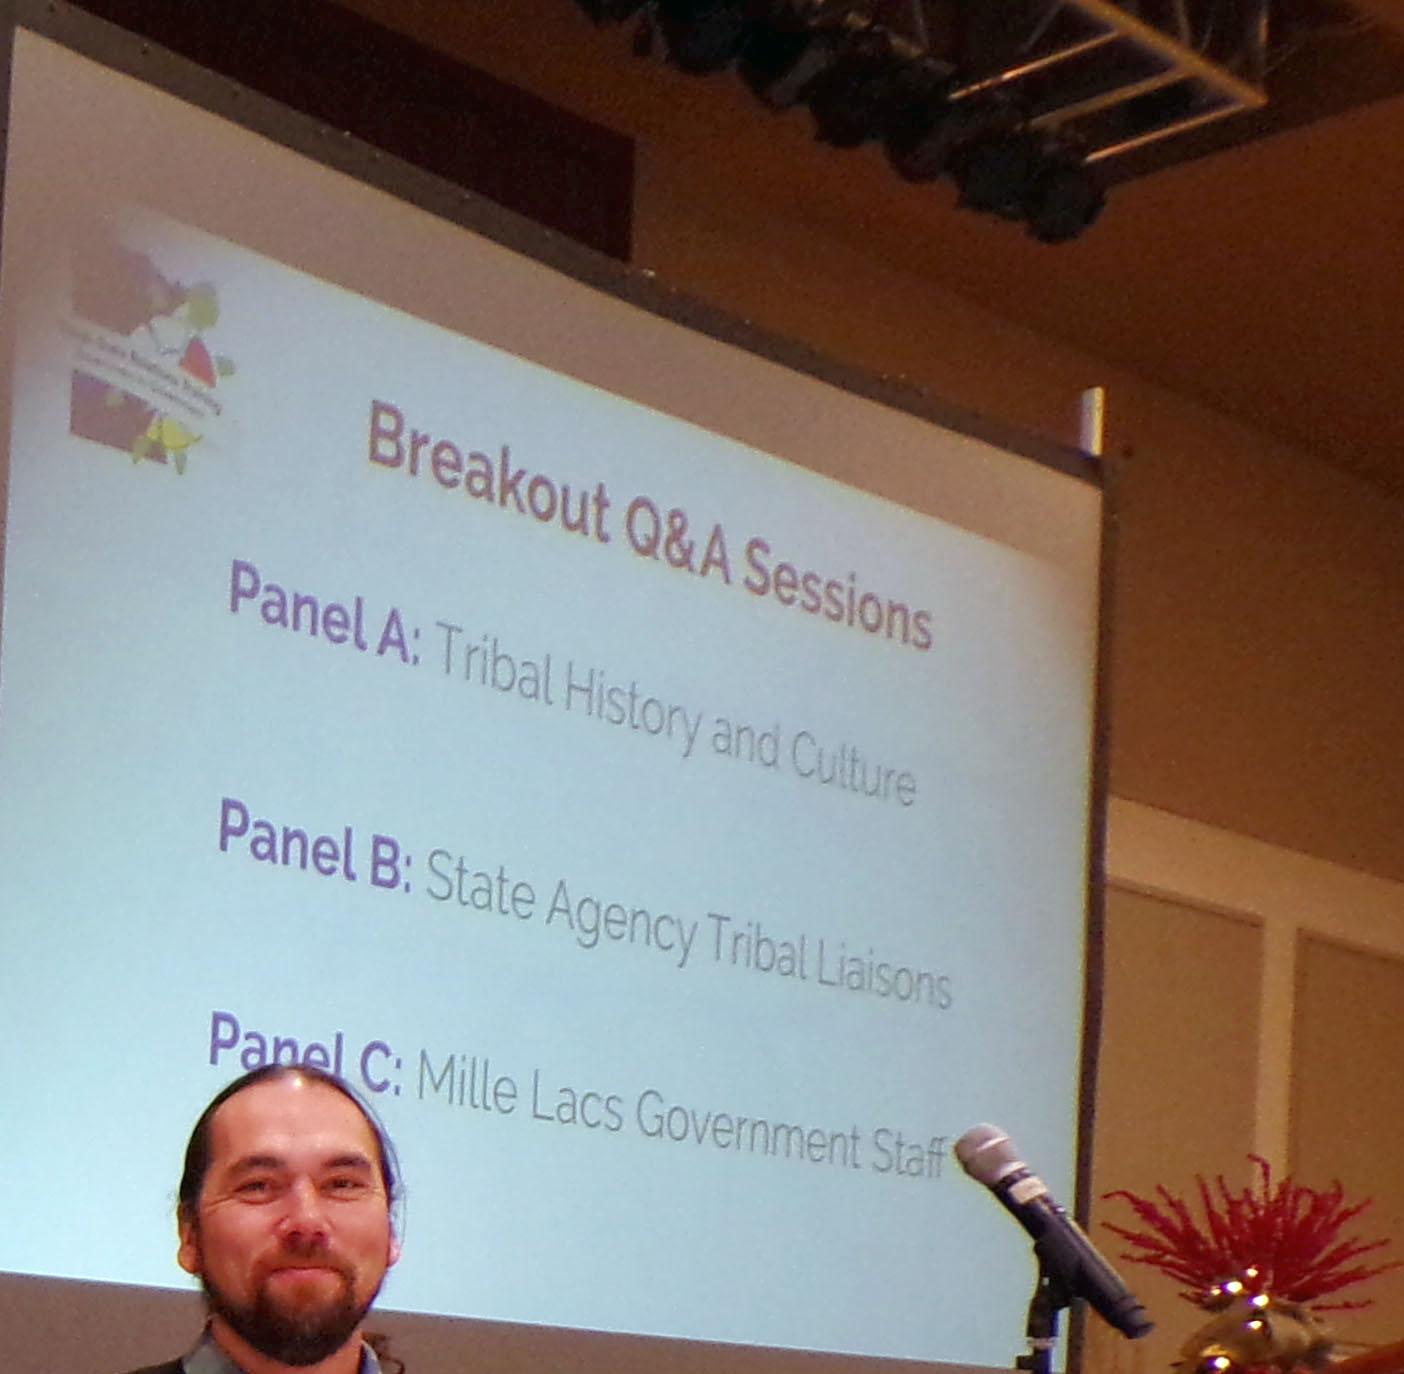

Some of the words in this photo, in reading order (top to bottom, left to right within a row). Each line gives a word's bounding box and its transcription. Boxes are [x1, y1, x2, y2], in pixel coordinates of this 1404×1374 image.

[369, 399, 611, 543] Breakout
[626, 495, 730, 585] Q&A
[743, 537, 932, 650] Sessions
[230, 559, 368, 652] Panel
[376, 607, 420, 666] A:
[436, 620, 552, 706] Tribal
[566, 660, 703, 759] History
[712, 717, 780, 768] and
[792, 730, 917, 807] Culture
[220, 797, 357, 881] Panel
[370, 833, 411, 893] B:
[427, 849, 535, 920] State
[545, 879, 698, 968] Agency
[708, 912, 807, 981] Tribal
[818, 938, 952, 1010] Liaisons
[209, 1010, 344, 1076] Panel
[360, 1040, 402, 1096] C:
[418, 1048, 517, 1114] Mille
[532, 1068, 623, 1132] Lacs
[637, 1089, 861, 1169] Government
[872, 1128, 948, 1178] Staff
